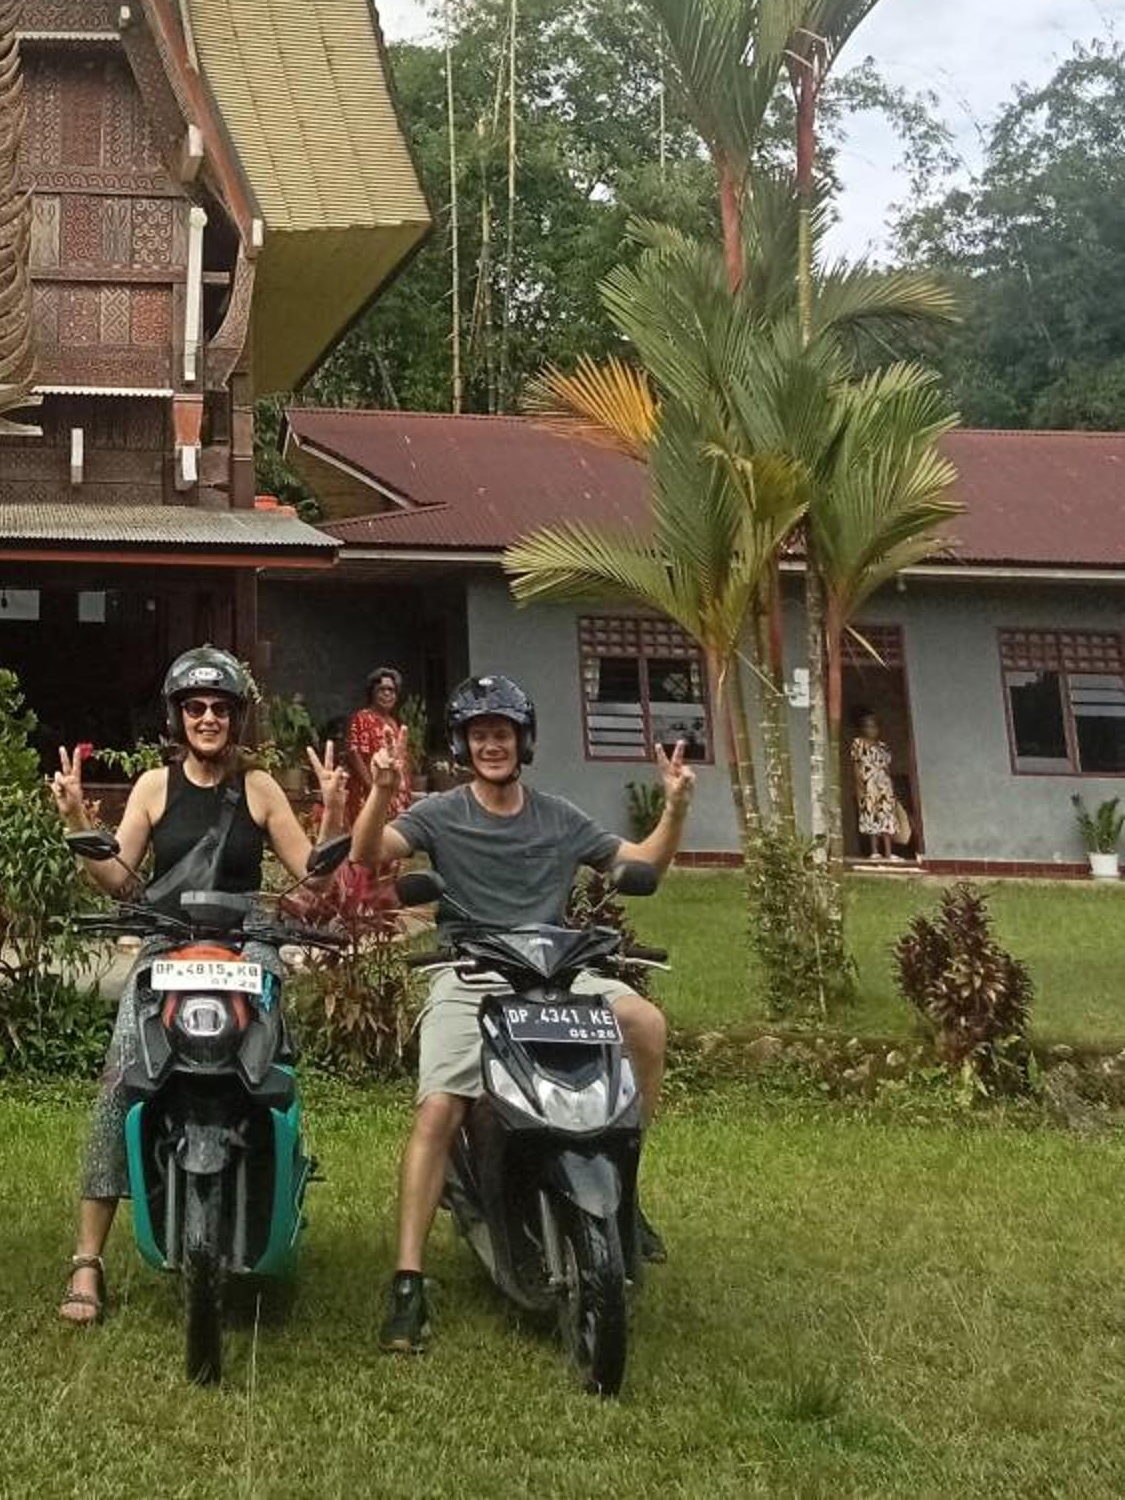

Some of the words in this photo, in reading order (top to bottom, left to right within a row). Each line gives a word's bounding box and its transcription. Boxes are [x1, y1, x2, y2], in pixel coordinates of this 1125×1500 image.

[156, 963, 174, 975] DP
[508, 1009, 529, 1024] DP
[540, 1008, 581, 1025] 4341
[589, 1009, 614, 1026] KE
